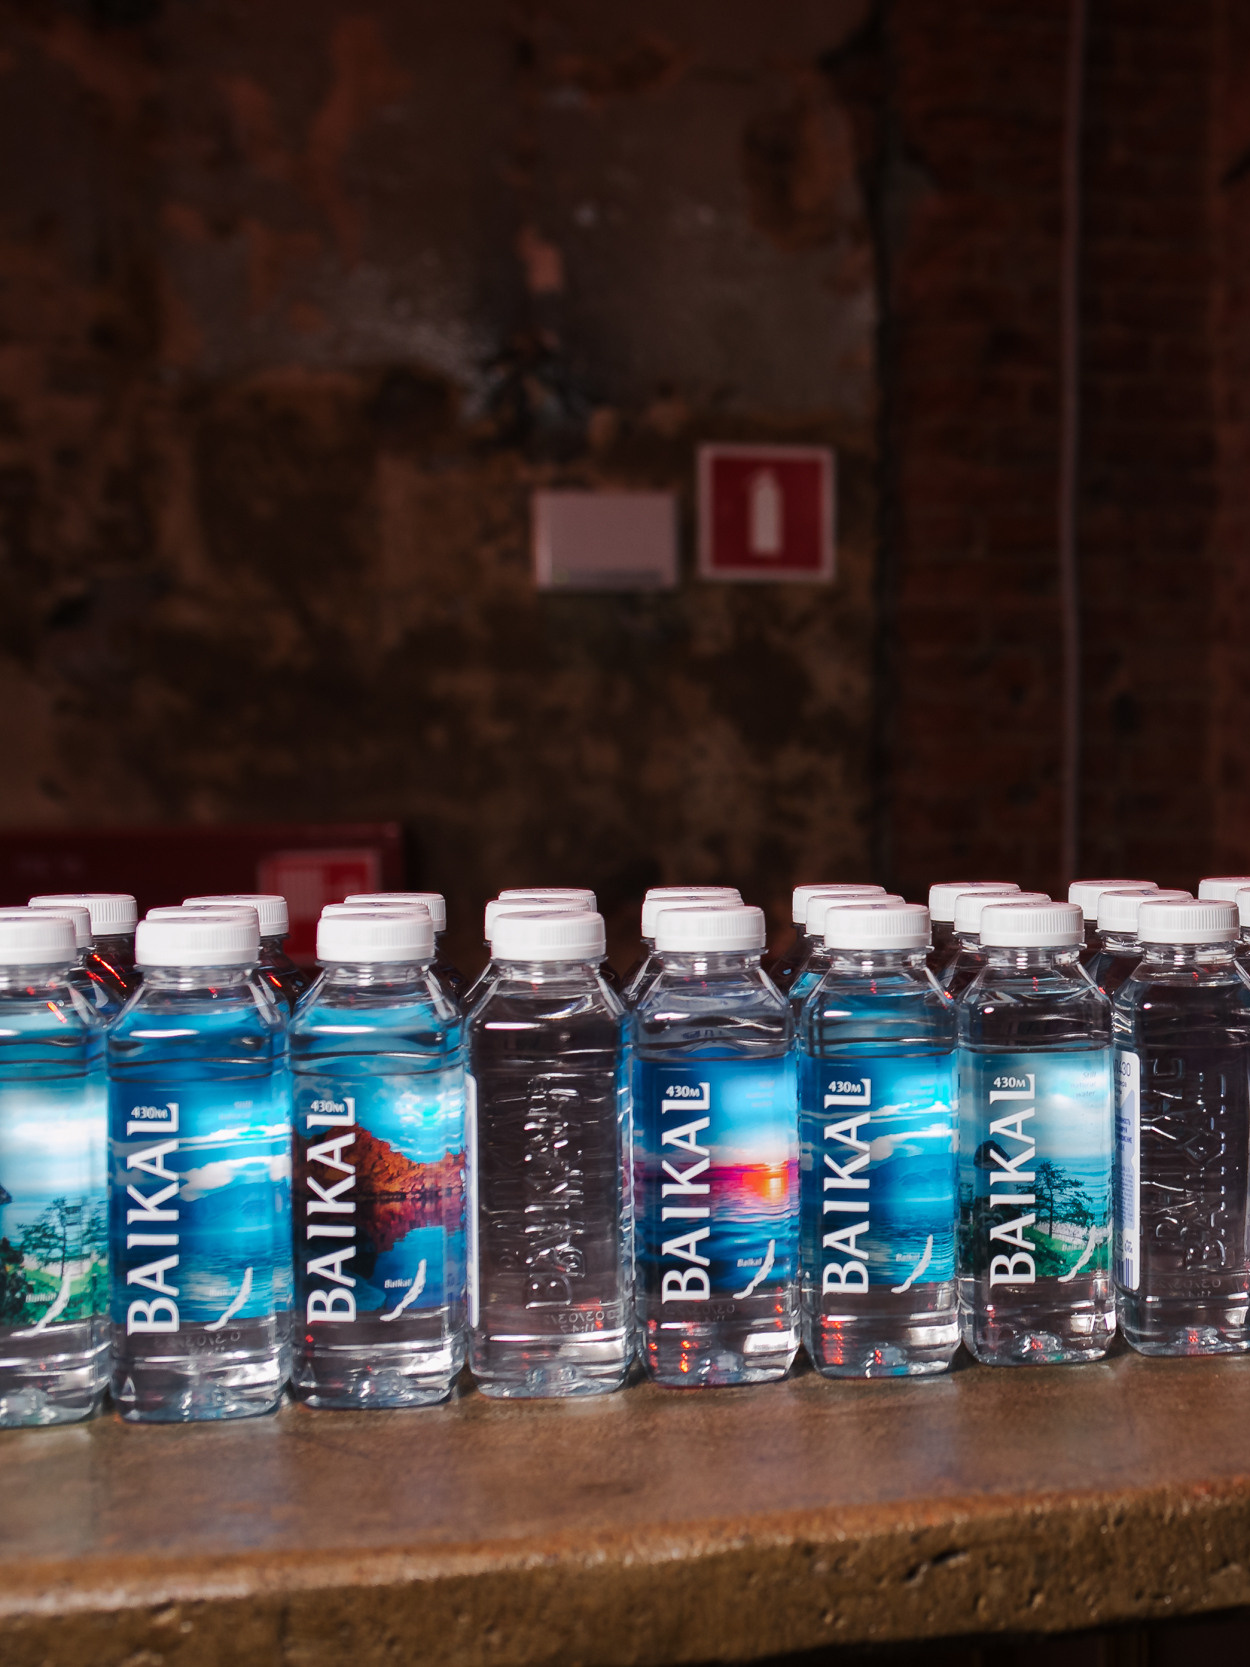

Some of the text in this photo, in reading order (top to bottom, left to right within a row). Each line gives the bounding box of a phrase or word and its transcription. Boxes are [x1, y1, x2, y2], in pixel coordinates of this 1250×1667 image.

[127, 1103, 179, 1336] BAIKAL
[307, 1097, 356, 1326] BAIKAL
[662, 1082, 710, 1304] BAIKAL
[823, 1078, 871, 1296] BAIKAL
[990, 1073, 1035, 1289] BAIKAL
